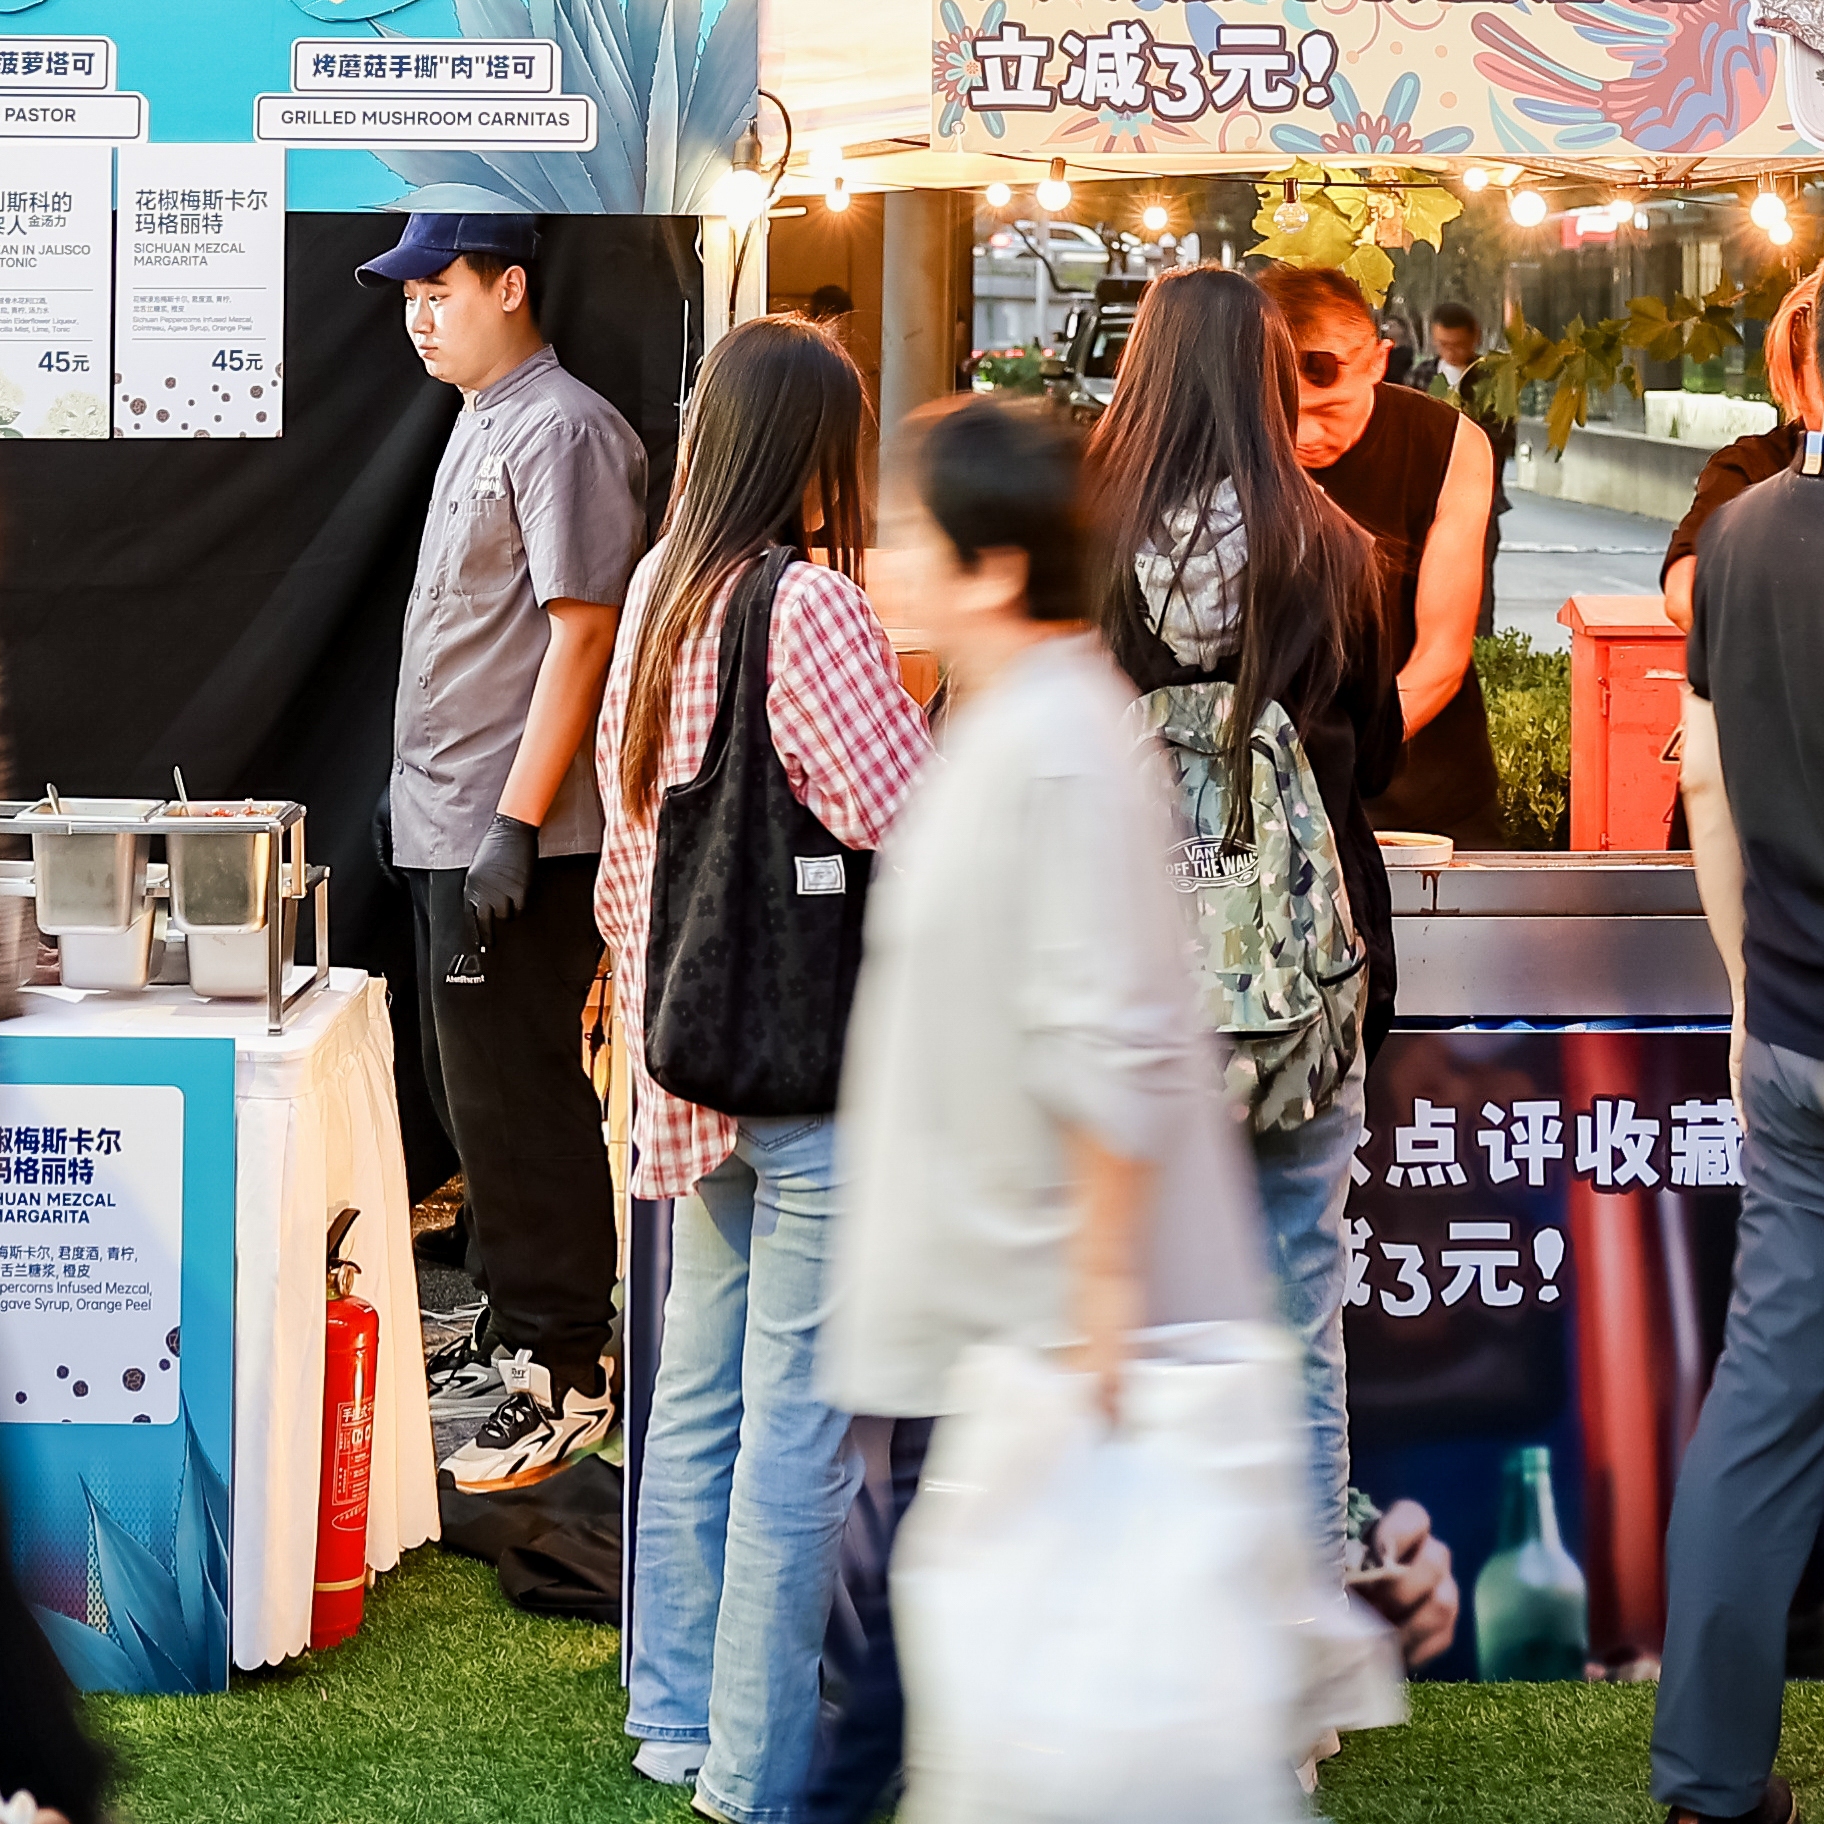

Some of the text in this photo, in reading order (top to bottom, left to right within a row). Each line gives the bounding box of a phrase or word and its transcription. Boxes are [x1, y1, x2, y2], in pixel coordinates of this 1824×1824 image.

[971, 23, 1339, 118] 立减3元!
[5, 107, 75, 122] PASTOR
[282, 110, 569, 127] GRILLED MUSHROOM CARNITAS
[135, 188, 268, 212] 花椒梅斯卡尔
[135, 212, 224, 235] 玛格丽特
[23, 244, 35, 255] IN
[39, 244, 90, 256] JALISCO
[134, 242, 245, 254] SICHUAN MEZCAL
[134, 255, 208, 267] MARGARITA
[38, 350, 90, 373] 45元
[211, 349, 264, 372] 45元
[1192, 859, 1221, 878] THE
[47, 1192, 116, 1208] MEZCAL
[63, 1263, 91, 1279] 橙皮
[56, 1281, 102, 1294] Infused
[105, 1282, 153, 1296] Mezcal,
[34, 1298, 73, 1314] Syrup,
[76, 1299, 122, 1314] Orange
[125, 1299, 152, 1312] Peel
